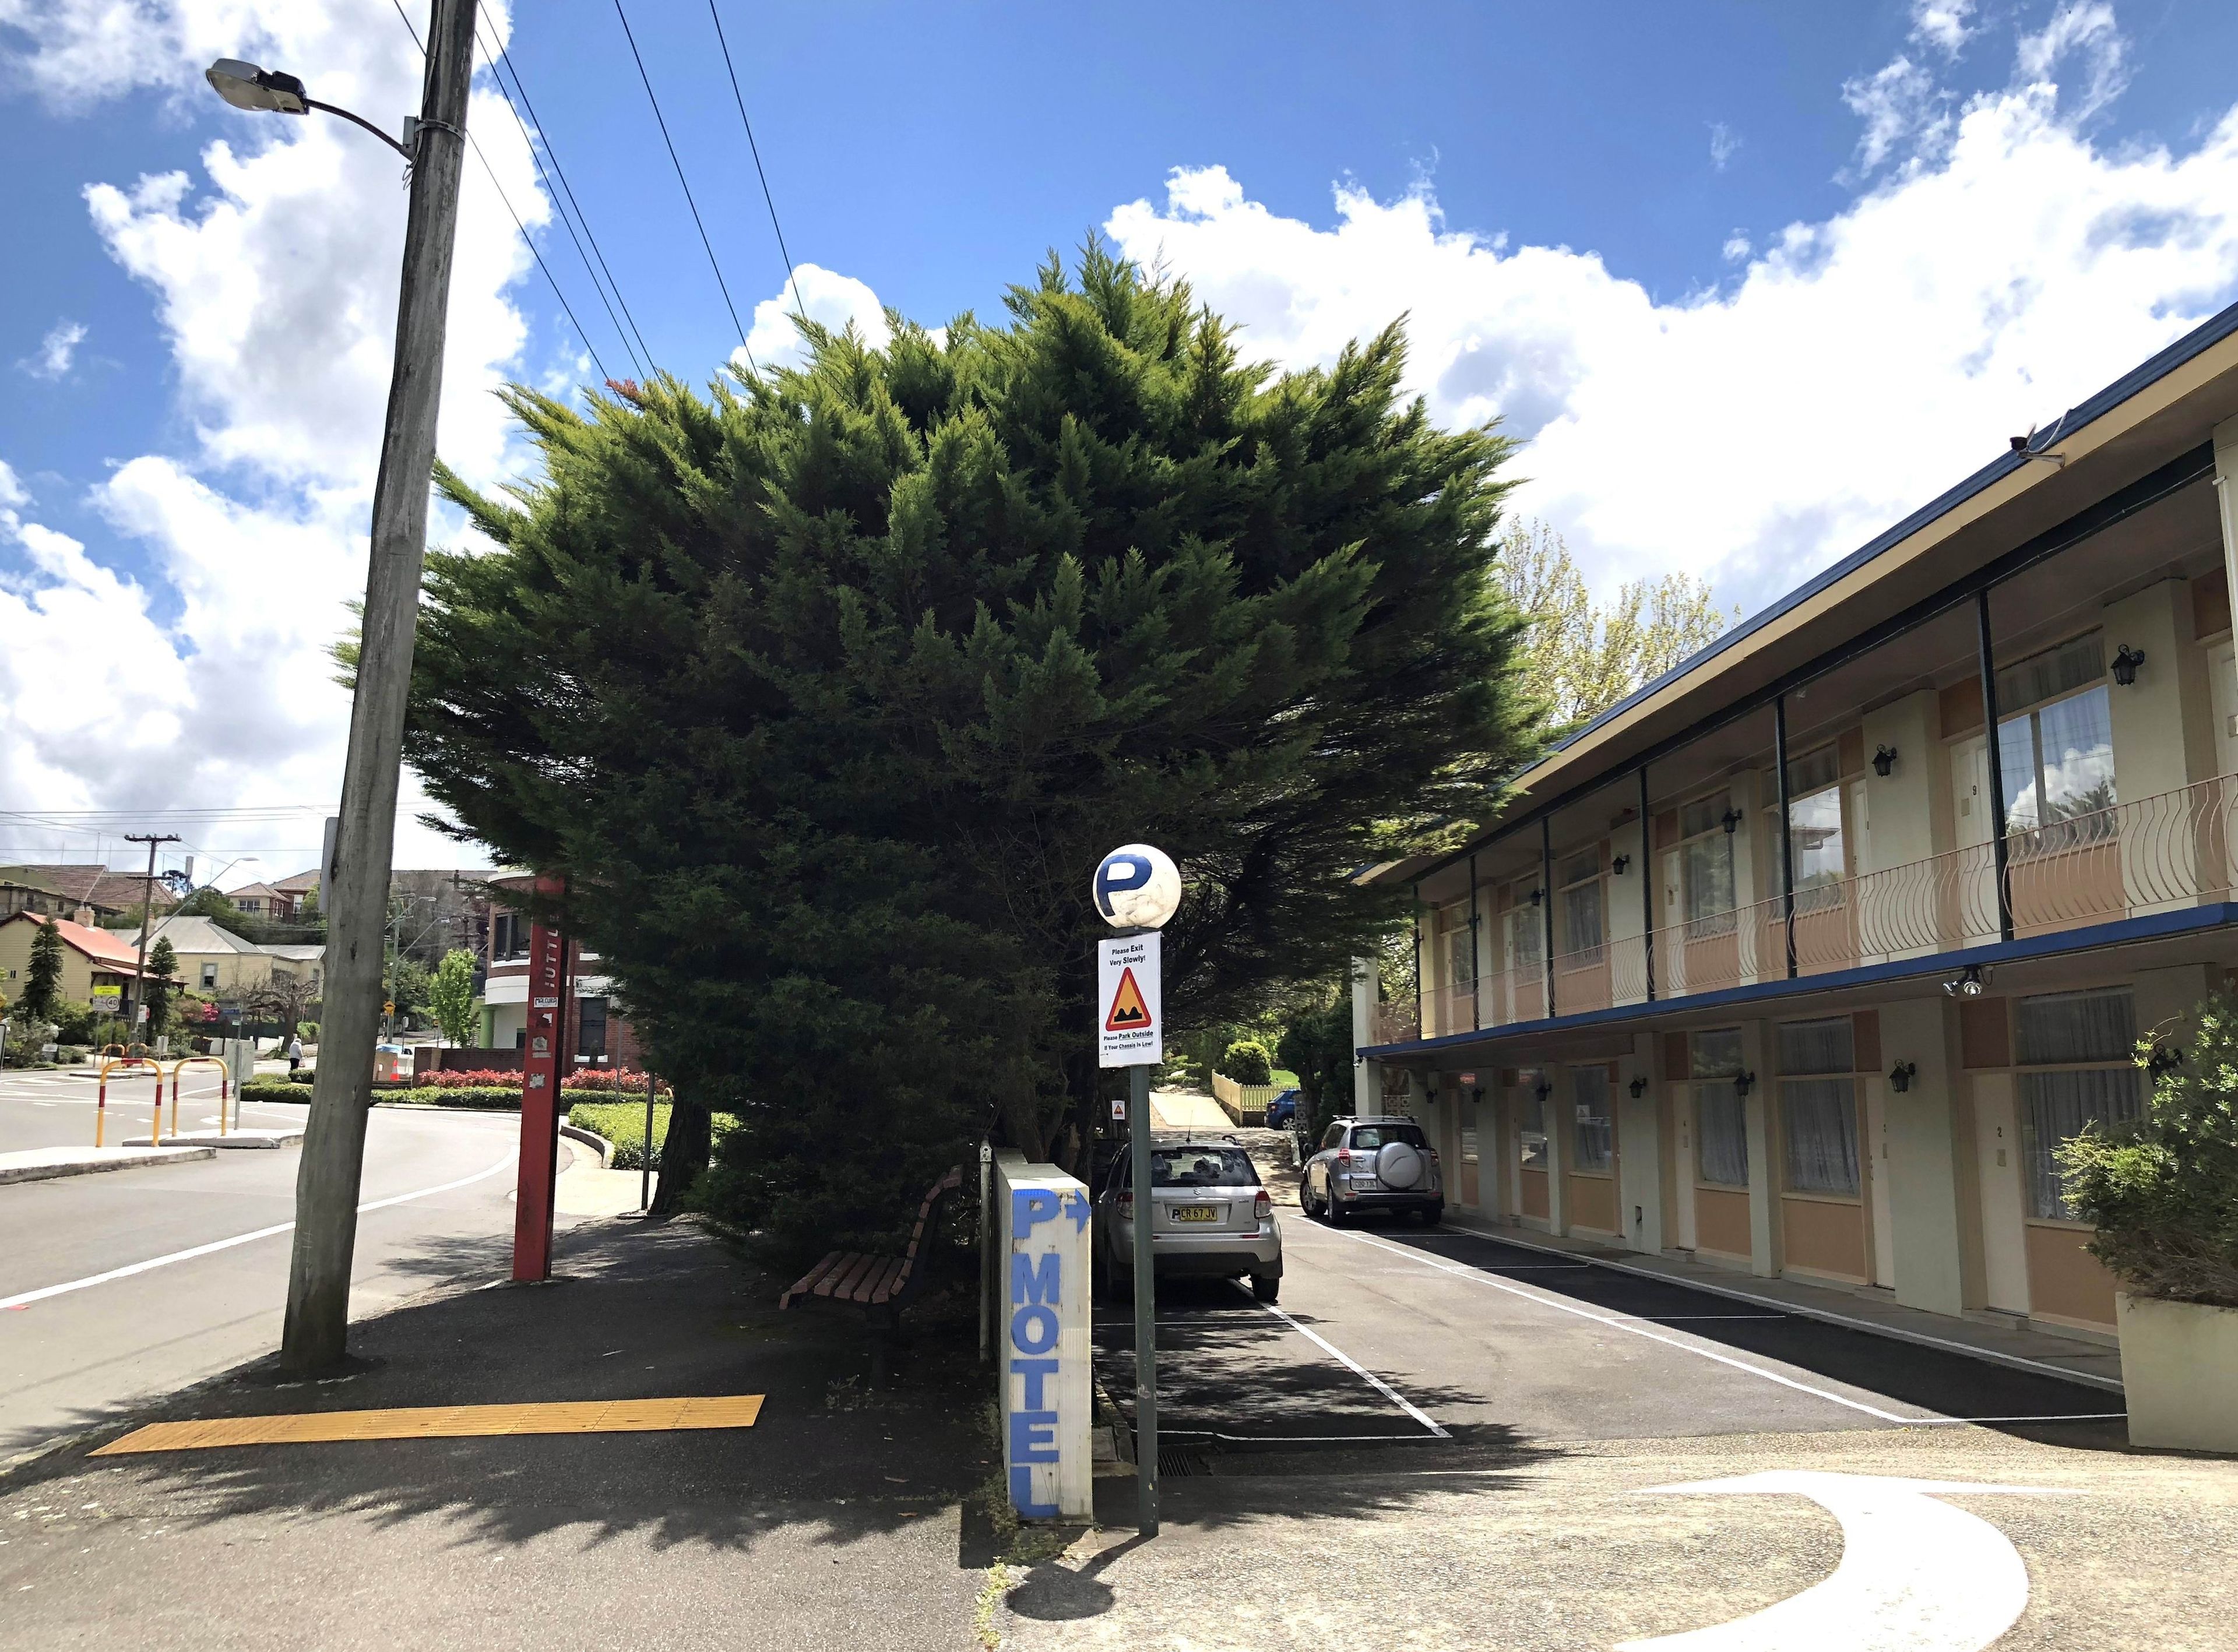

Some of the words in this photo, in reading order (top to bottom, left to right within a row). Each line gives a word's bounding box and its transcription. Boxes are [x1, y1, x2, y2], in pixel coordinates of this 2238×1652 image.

[1972, 785, 1977, 796] 9
[1096, 854, 1152, 917] P
[1131, 944, 1143, 952] Exit
[1123, 955, 1146, 964] Slowly!
[1997, 1126, 2002, 1137] 2
[1012, 1189, 1061, 1239] P
[1171, 1209, 1180, 1219] P
[1205, 1210, 1215, 1218] JV
[1010, 1253, 1061, 1517] MOTEL
